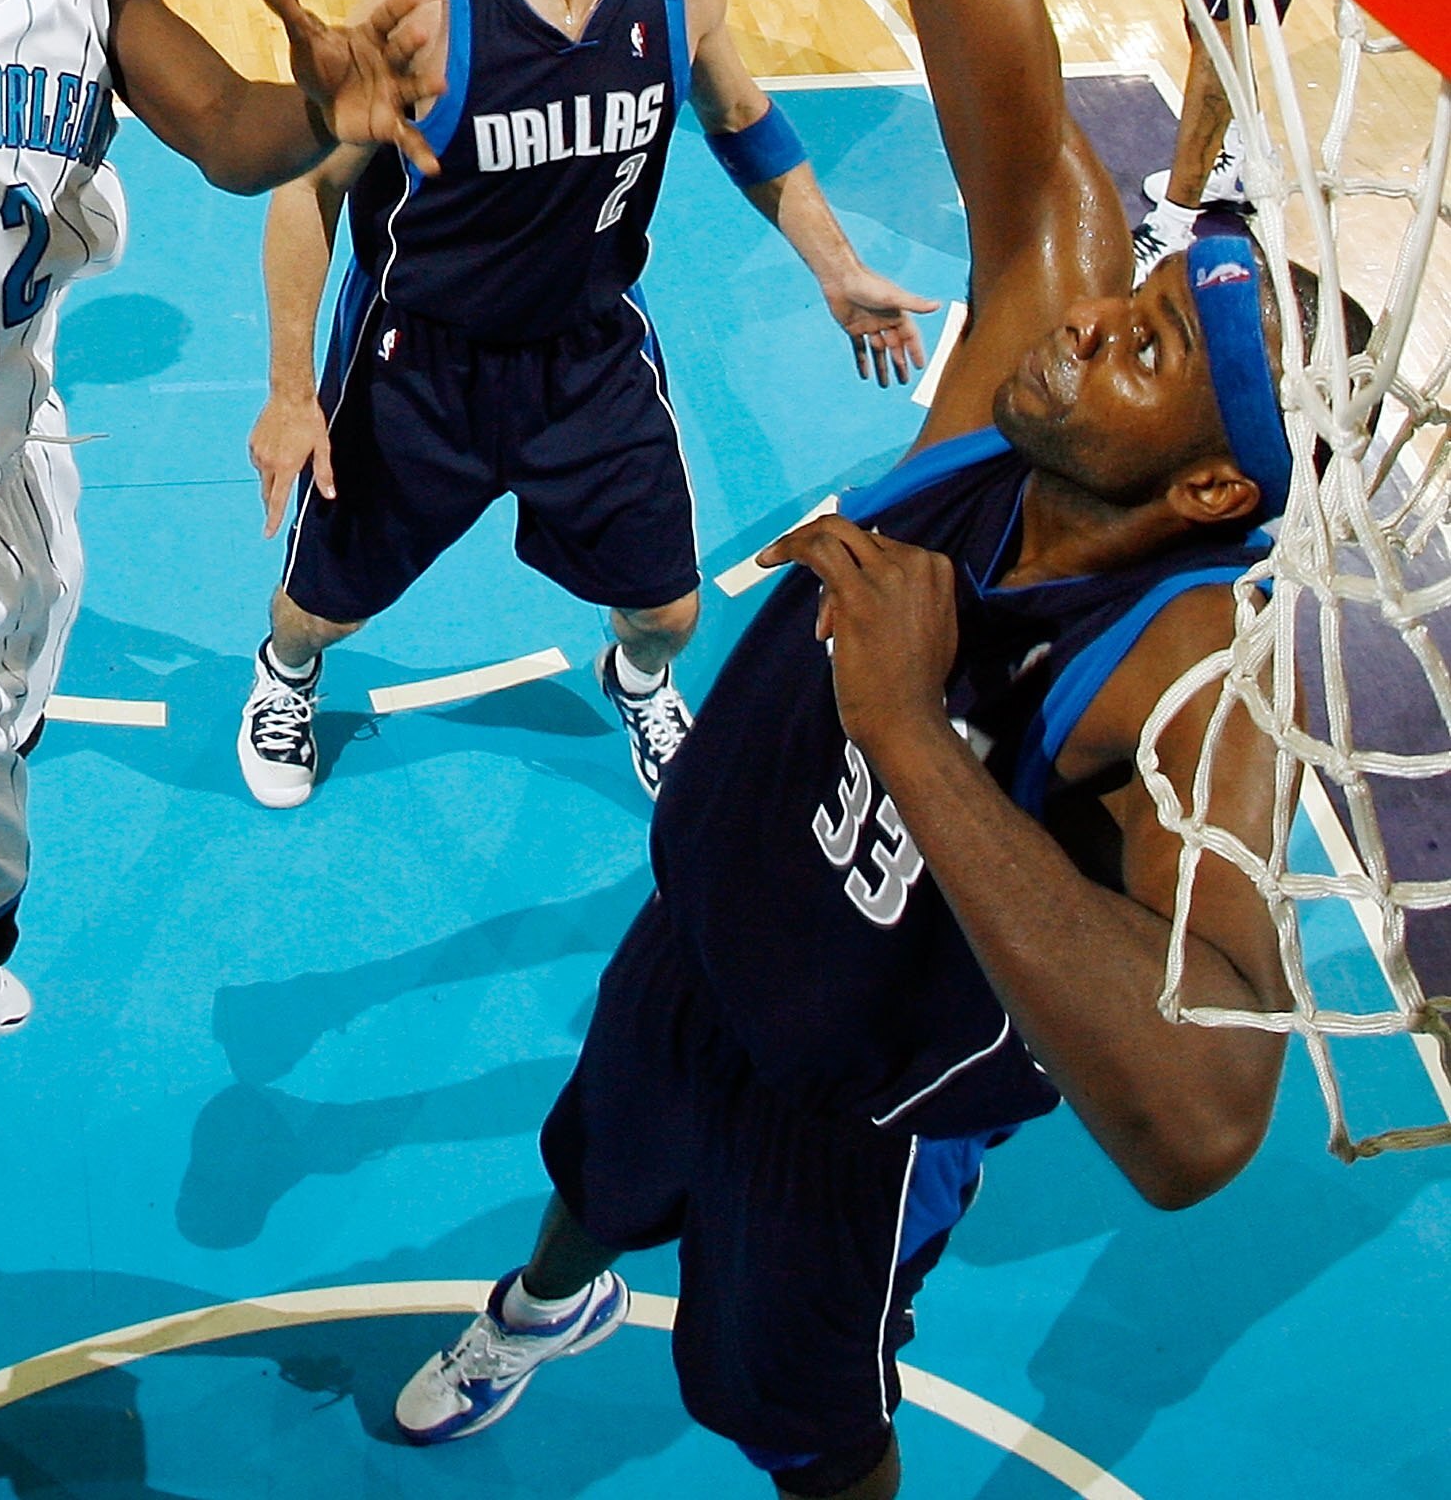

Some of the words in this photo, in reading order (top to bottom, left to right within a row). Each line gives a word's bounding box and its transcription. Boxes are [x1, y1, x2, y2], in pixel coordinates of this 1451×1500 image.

[472, 81, 666, 173] DALLAS
[594, 152, 648, 234] 2
[811, 737, 925, 926] 33
